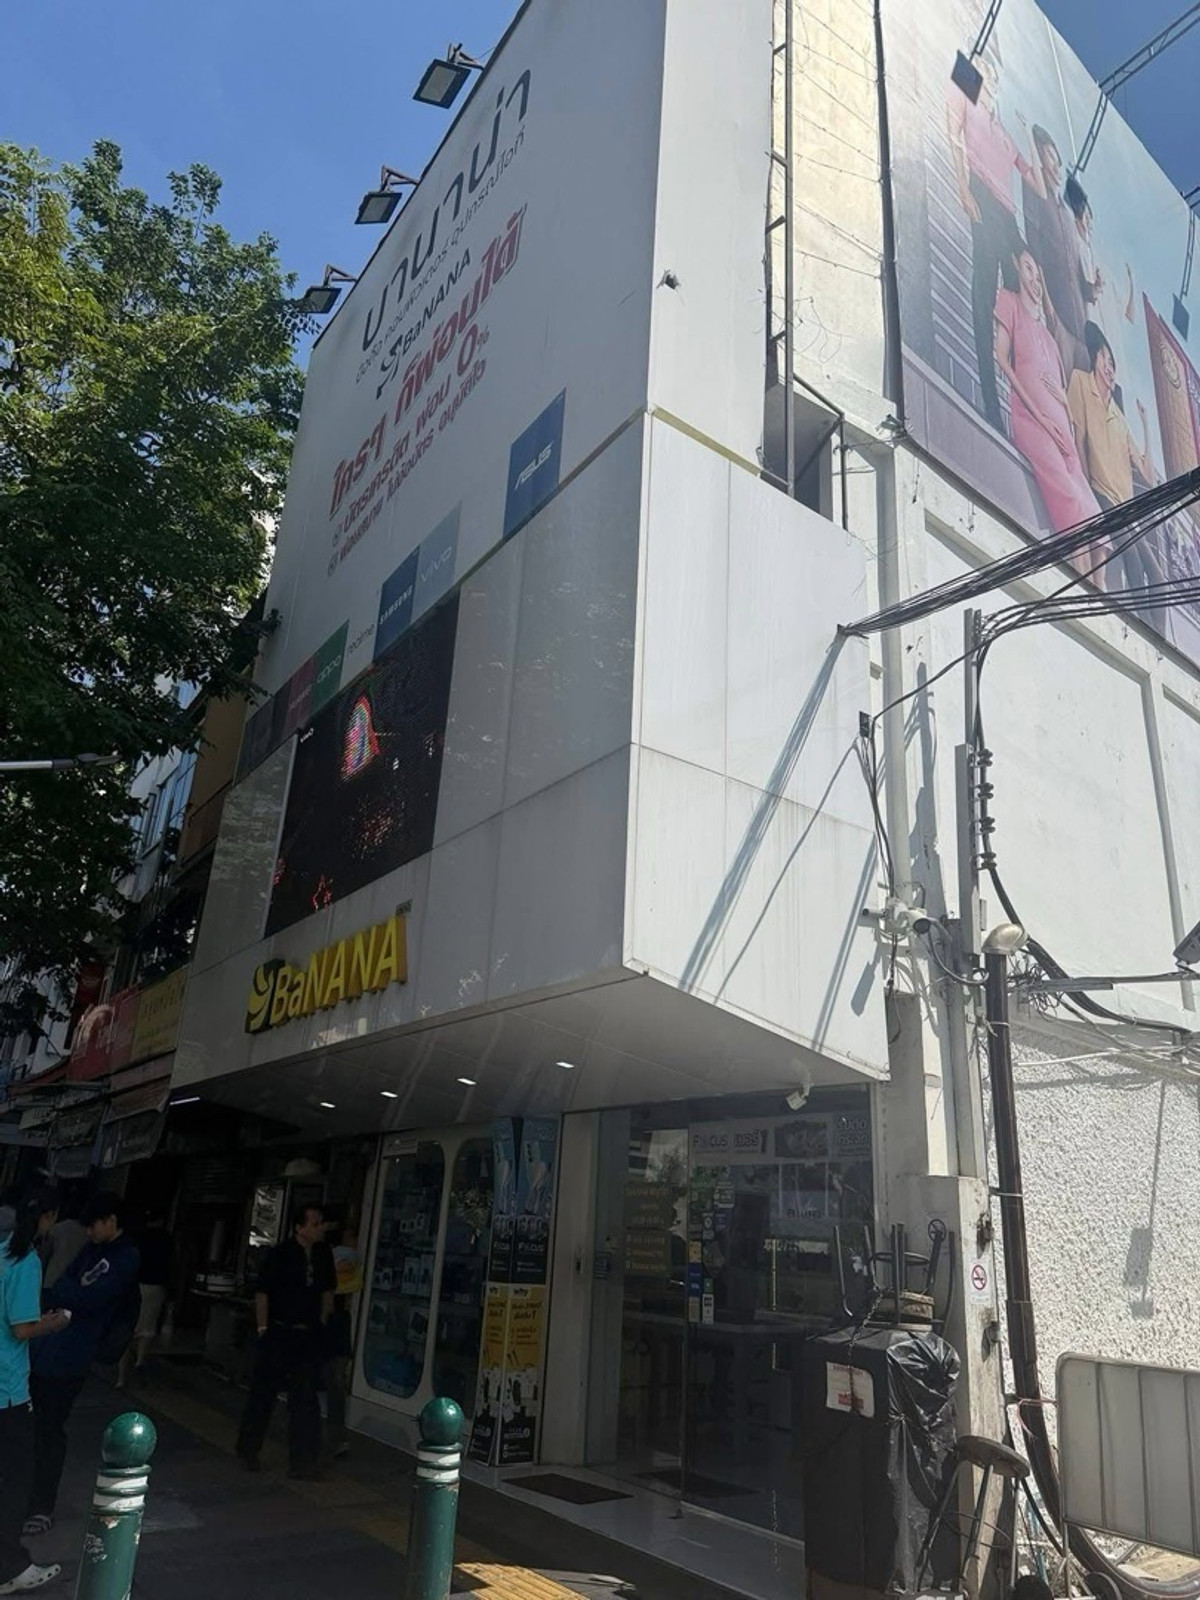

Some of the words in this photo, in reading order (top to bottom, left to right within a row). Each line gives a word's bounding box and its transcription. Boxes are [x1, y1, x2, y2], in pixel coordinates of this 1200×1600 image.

[362, 68, 531, 352] บานาน่า
[401, 248, 472, 352] BaNANA
[328, 413, 386, 519] ใครๆ
[394, 204, 527, 424] ก็ผ่อนได้
[344, 432, 410, 535] บัตรเครดิต
[416, 375, 450, 436] ผ่อน
[513, 443, 552, 491] ASUS
[380, 585, 412, 625] SAMSUNG
[270, 916, 405, 1026] BaNANA
